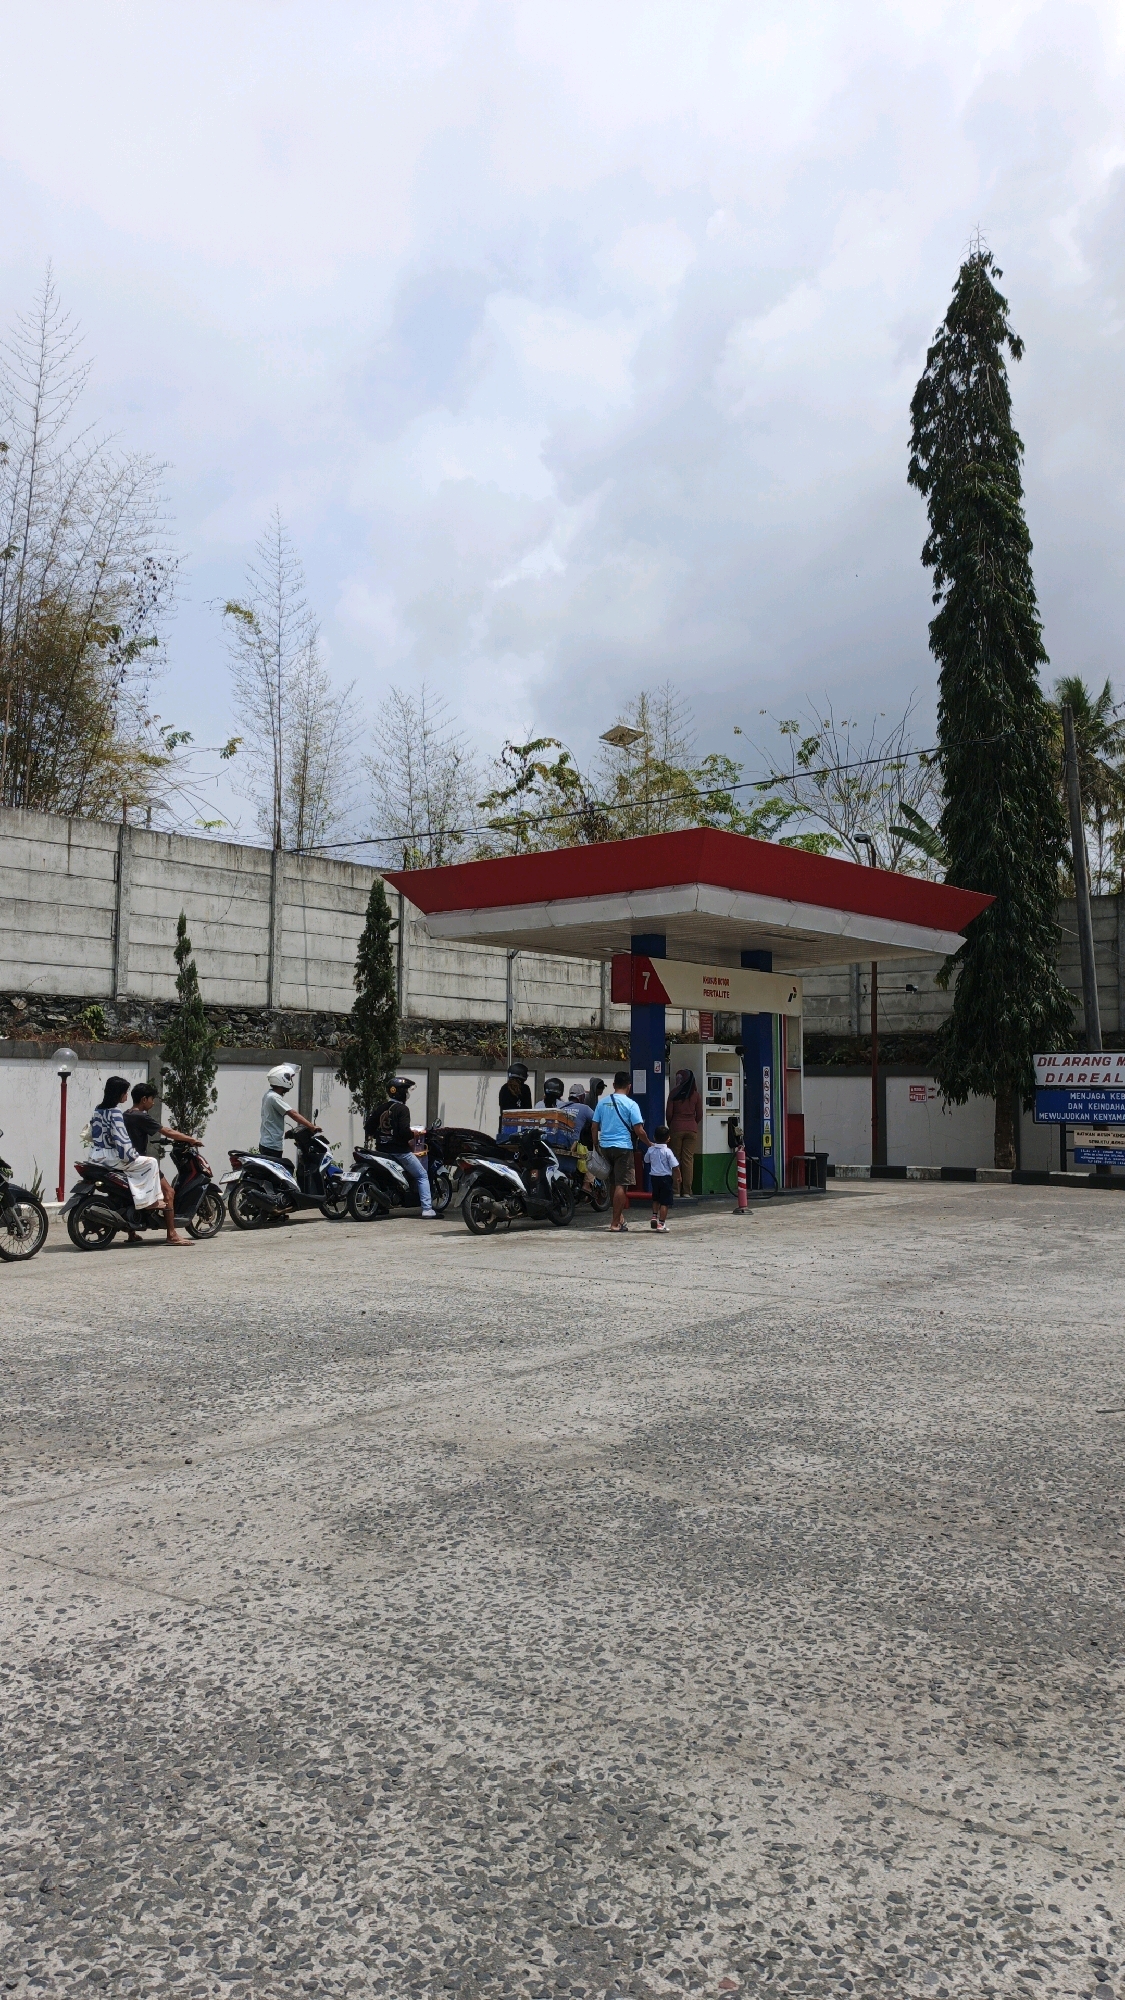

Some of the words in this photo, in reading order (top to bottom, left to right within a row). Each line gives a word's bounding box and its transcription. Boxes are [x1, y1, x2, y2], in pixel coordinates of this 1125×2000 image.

[642, 971, 651, 990] 7
[703, 988, 730, 999] PERTALITE
[1037, 1057, 1112, 1067] DILARANG
[1070, 1092, 1106, 1100] MENJAGA
[1039, 1112, 1090, 1120] MEWUJUDKAN
